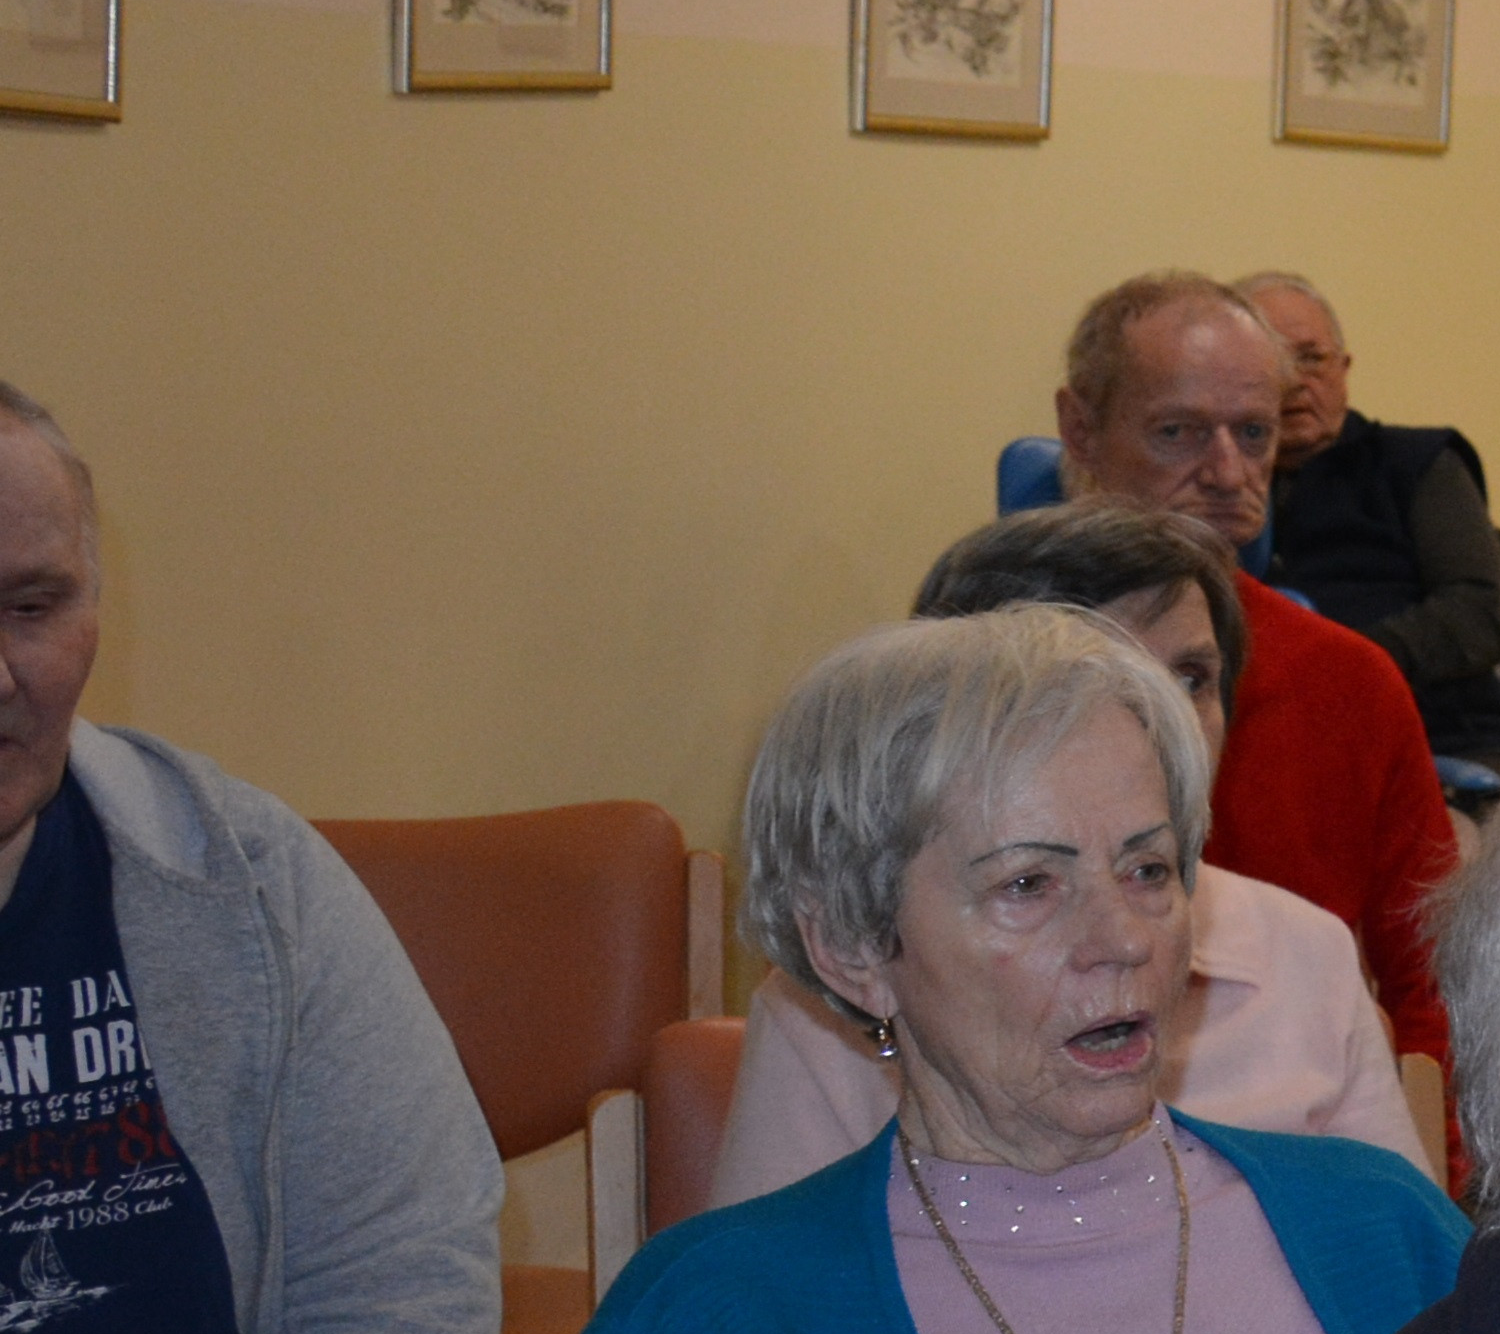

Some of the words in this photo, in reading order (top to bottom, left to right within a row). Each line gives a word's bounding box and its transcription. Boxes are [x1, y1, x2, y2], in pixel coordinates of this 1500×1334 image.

[73, 1090, 93, 1105] 66
[75, 1106, 92, 1121] 25
[0, 1179, 96, 1216] Good
[103, 1160, 188, 1202] Times
[67, 1201, 131, 1231] 1988
[134, 1197, 173, 1215] Club
